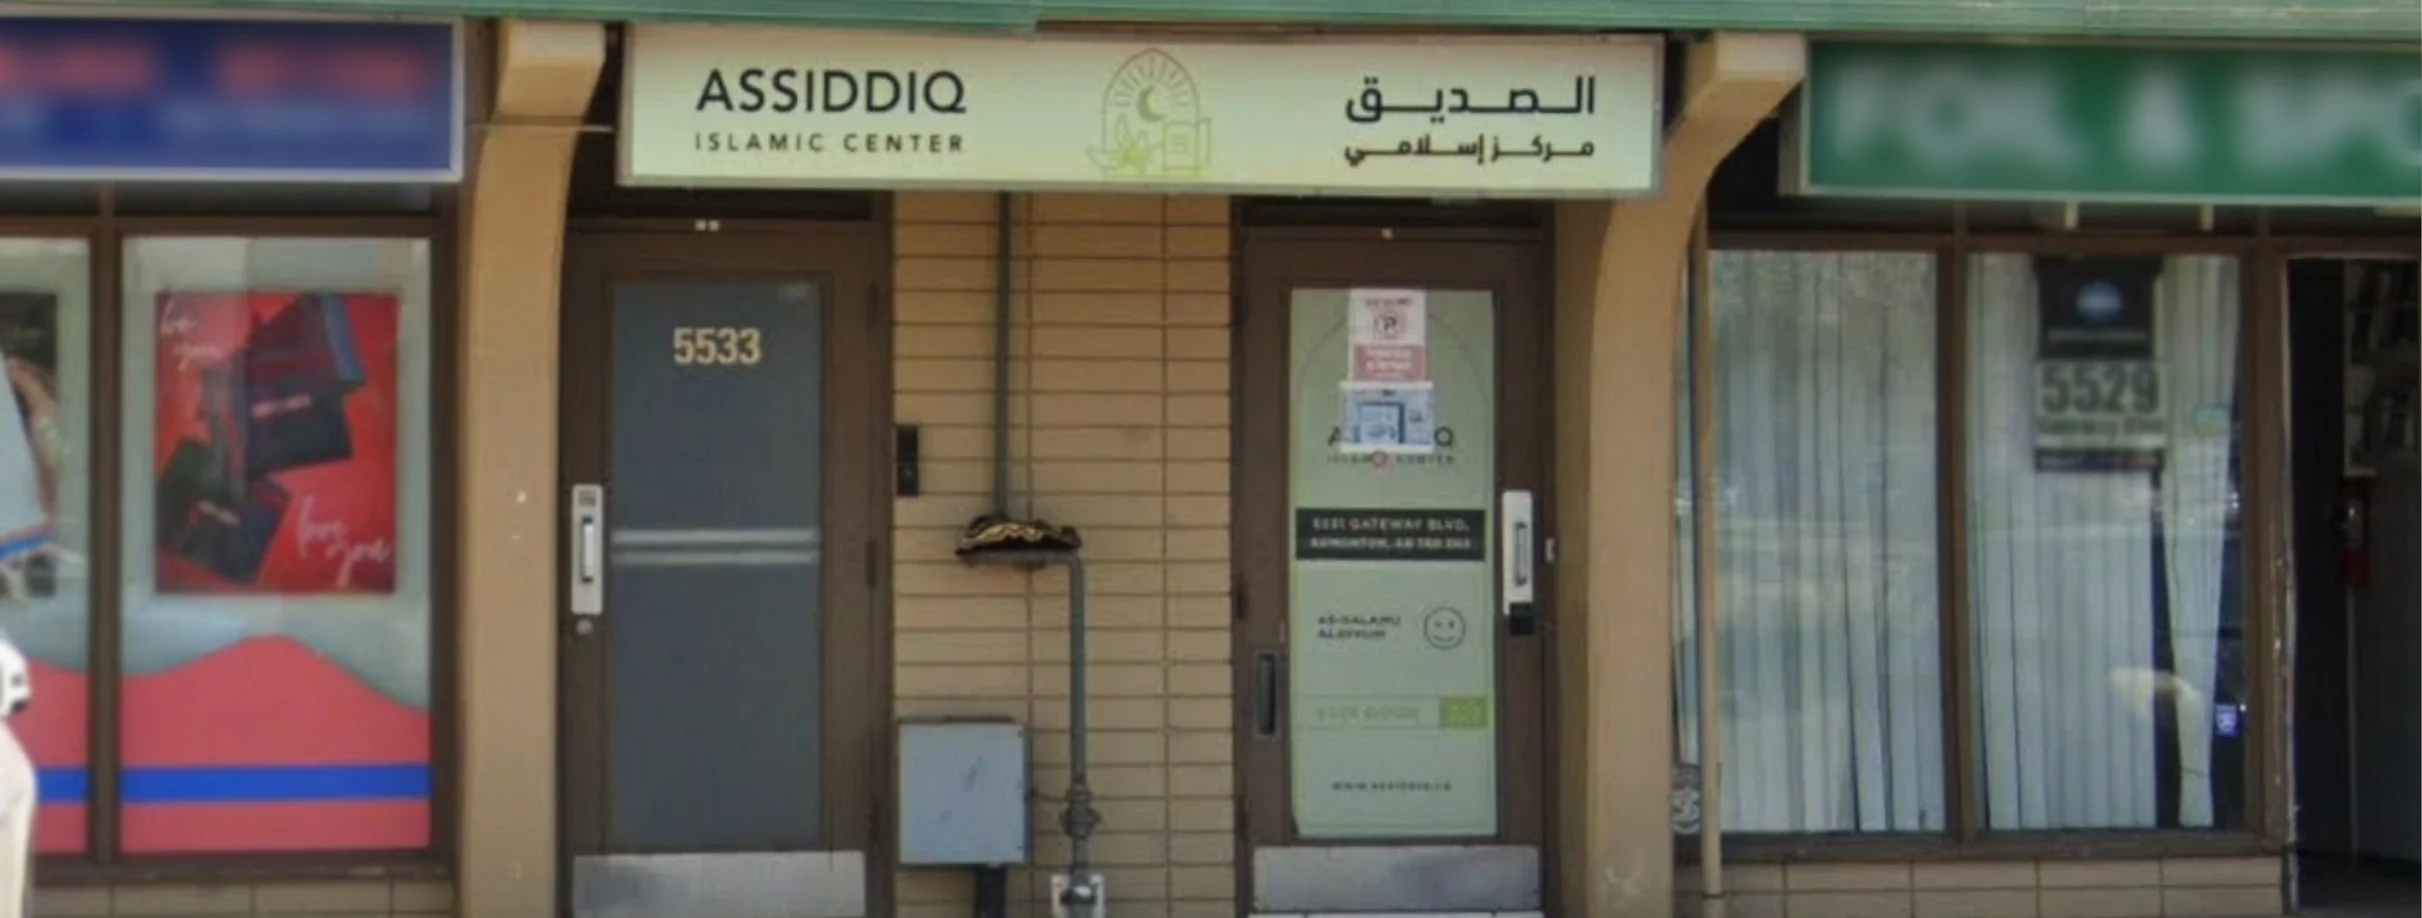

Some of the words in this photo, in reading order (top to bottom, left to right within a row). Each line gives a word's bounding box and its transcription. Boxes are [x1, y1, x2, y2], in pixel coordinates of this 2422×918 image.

[695, 67, 967, 114] ASSIDDIQ
[1344, 74, 1597, 124] الصديق
[695, 132, 824, 152] ISLAMIC
[842, 133, 963, 153] CENTER
[1343, 134, 1485, 168] إسلامي
[1490, 135, 1596, 163] مركز
[673, 327, 762, 365] 5533
[2041, 363, 2160, 414] 5529
